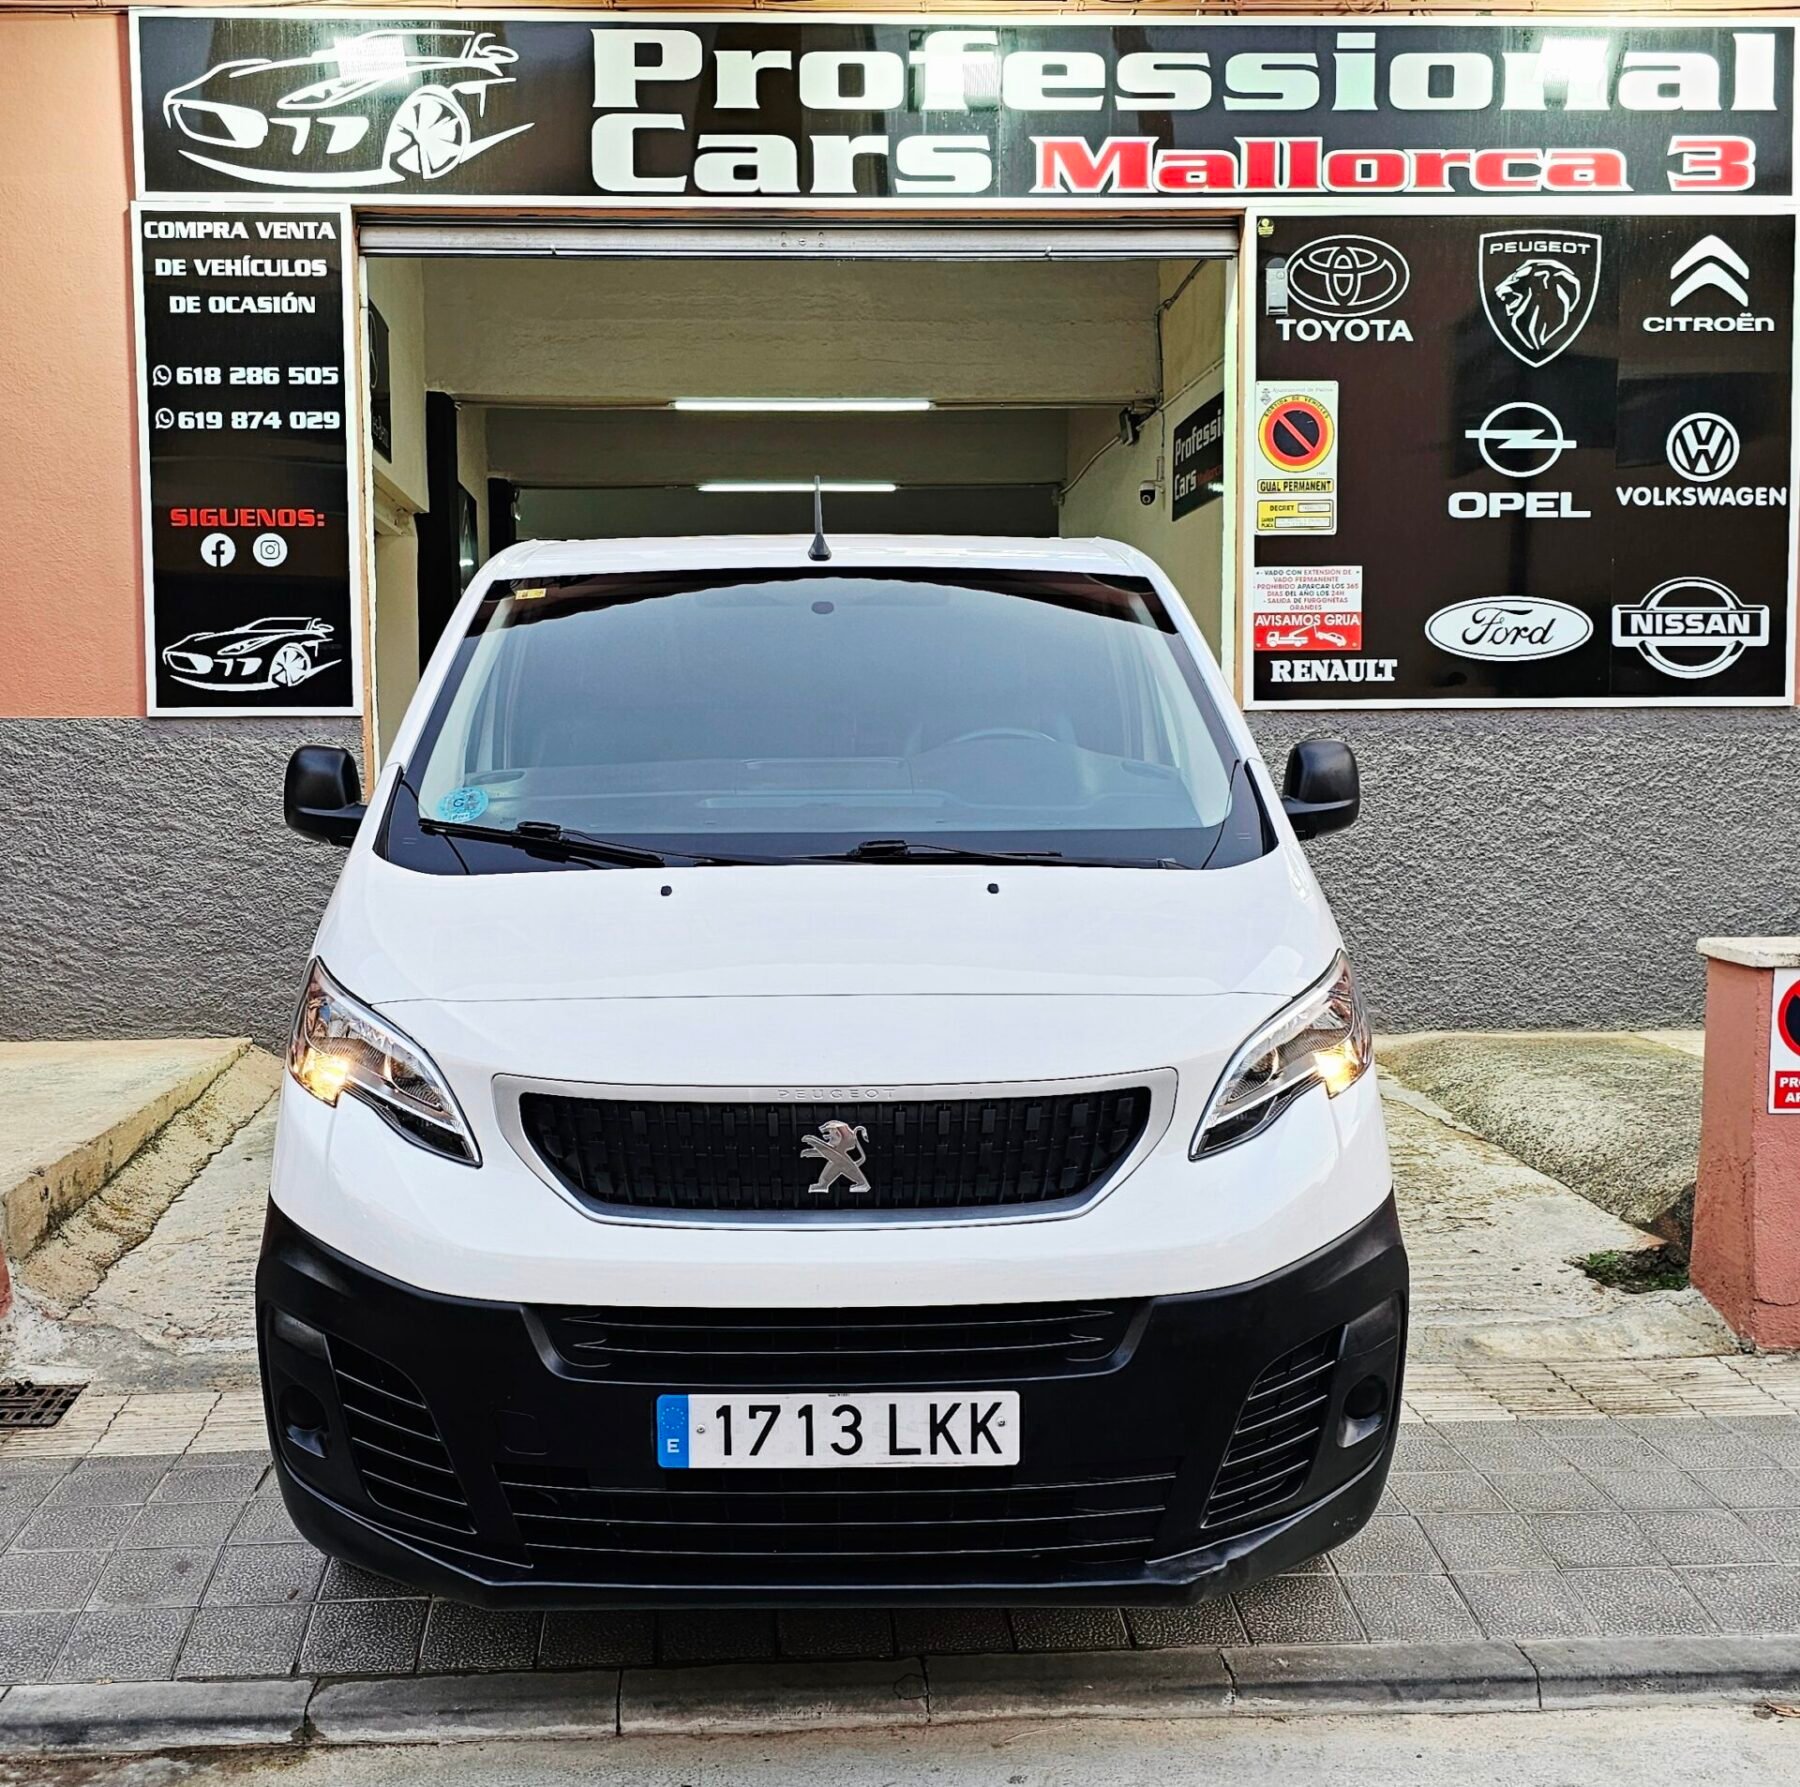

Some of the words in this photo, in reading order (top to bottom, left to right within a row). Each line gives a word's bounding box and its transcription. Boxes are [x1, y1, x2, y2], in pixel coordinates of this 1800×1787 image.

[591, 28, 1777, 112] Professional
[591, 113, 993, 194] Cars
[1029, 136, 1635, 194] Mallorca
[1666, 135, 1756, 193] 3
[144, 221, 249, 239] COMPRA
[255, 221, 337, 240] VENTA
[1489, 240, 1592, 255] PEUGEOT
[155, 258, 187, 276] DE
[193, 255, 328, 277] VEHÍCULOS
[169, 295, 202, 313] DE
[208, 292, 316, 314] OCASIÓN
[1275, 318, 1414, 342] TOYOTA
[176, 366, 222, 385] 618
[229, 366, 281, 385] 286
[288, 366, 339, 385] 505
[177, 411, 223, 430] 619
[231, 411, 282, 430] 874
[289, 411, 341, 430] 029
[1175, 408, 1224, 467] Professi
[1174, 469, 1197, 501] Cars
[1260, 481, 1281, 492] GUAL
[1283, 480, 1331, 492] PERMANENT
[1448, 491, 1592, 519] OPEL
[1615, 486, 1788, 507] VOLKSWAGEN
[170, 507, 325, 528] SIGUENOS:
[1255, 614, 1321, 626] AVISAMOS
[1324, 614, 1361, 626] GRUA
[1461, 606, 1556, 646] Ford
[1630, 613, 1750, 635] NISSAN
[1270, 659, 1398, 682] RENAULT
[1779, 1076, 1800, 1088] PR
[778, 1088, 896, 1100] PEUGEOT
[667, 1438, 680, 1453] E
[715, 1403, 863, 1457] 1713
[888, 1401, 1003, 1456] LKK
